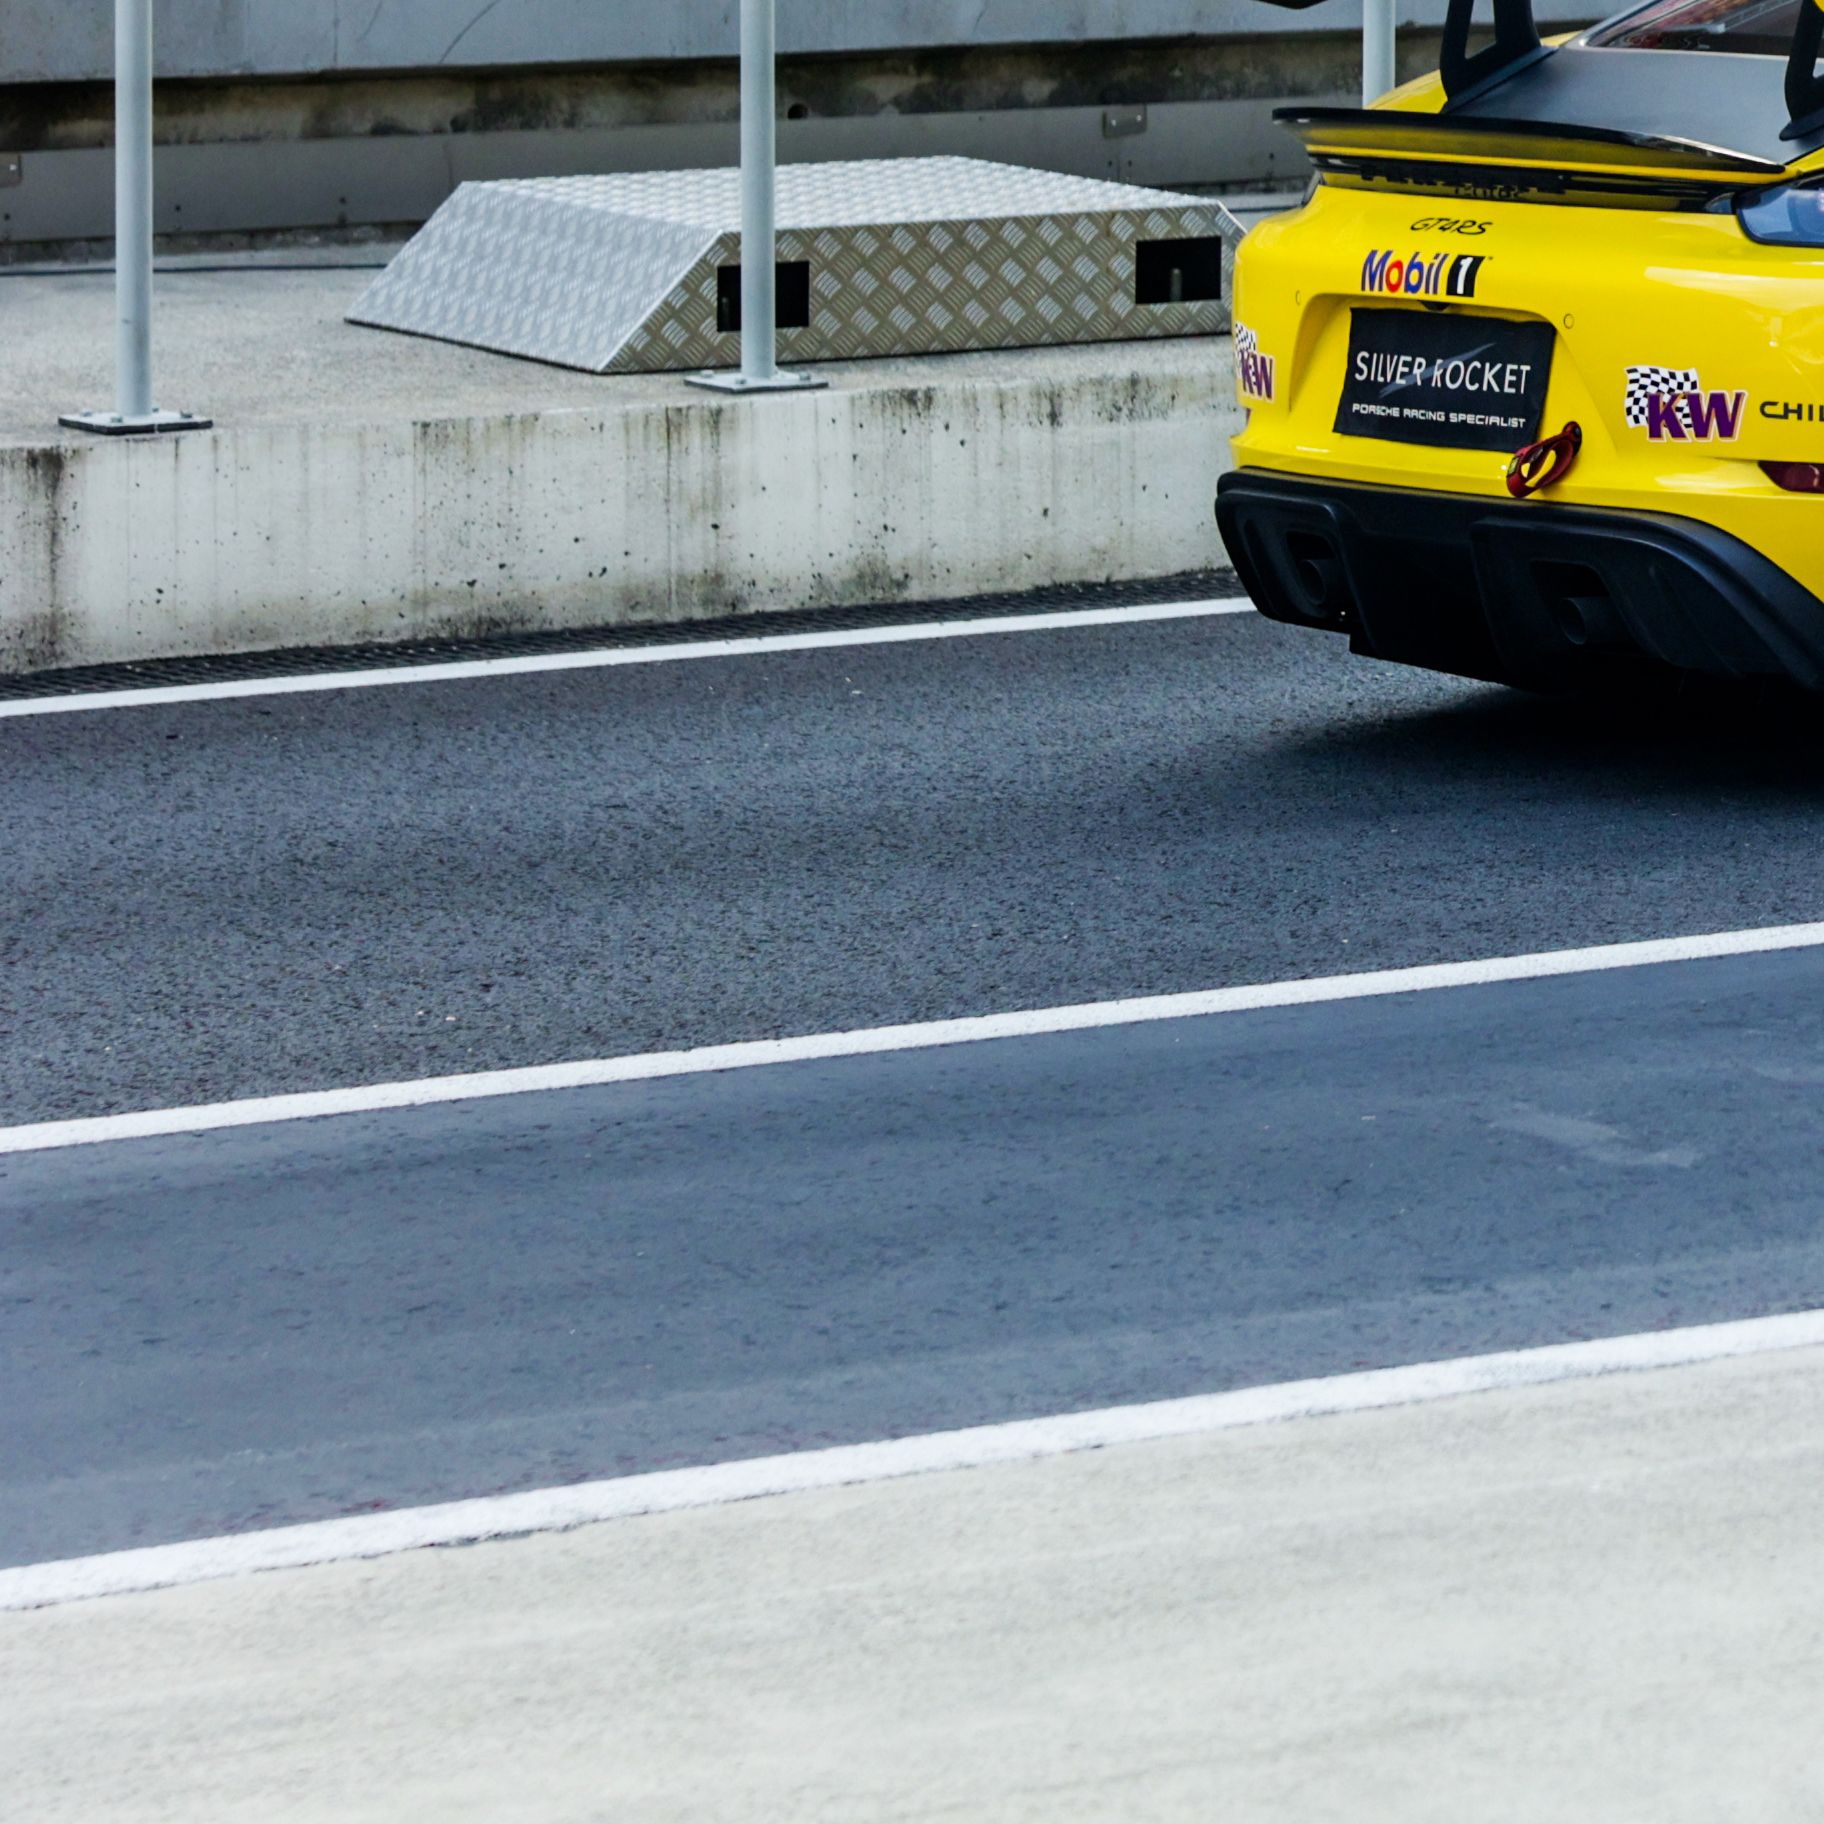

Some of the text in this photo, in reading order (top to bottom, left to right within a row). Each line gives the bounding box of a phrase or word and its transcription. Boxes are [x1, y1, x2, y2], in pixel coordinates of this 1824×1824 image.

[1410, 217, 1494, 236] GT4RS
[1361, 249, 1449, 295] Mobil
[1238, 348, 1273, 401] KW
[1354, 350, 1531, 395] SILVER ROCKET
[1352, 402, 1527, 429] PORSCHE RACING SPECIALIST
[1647, 391, 1746, 442] KW
